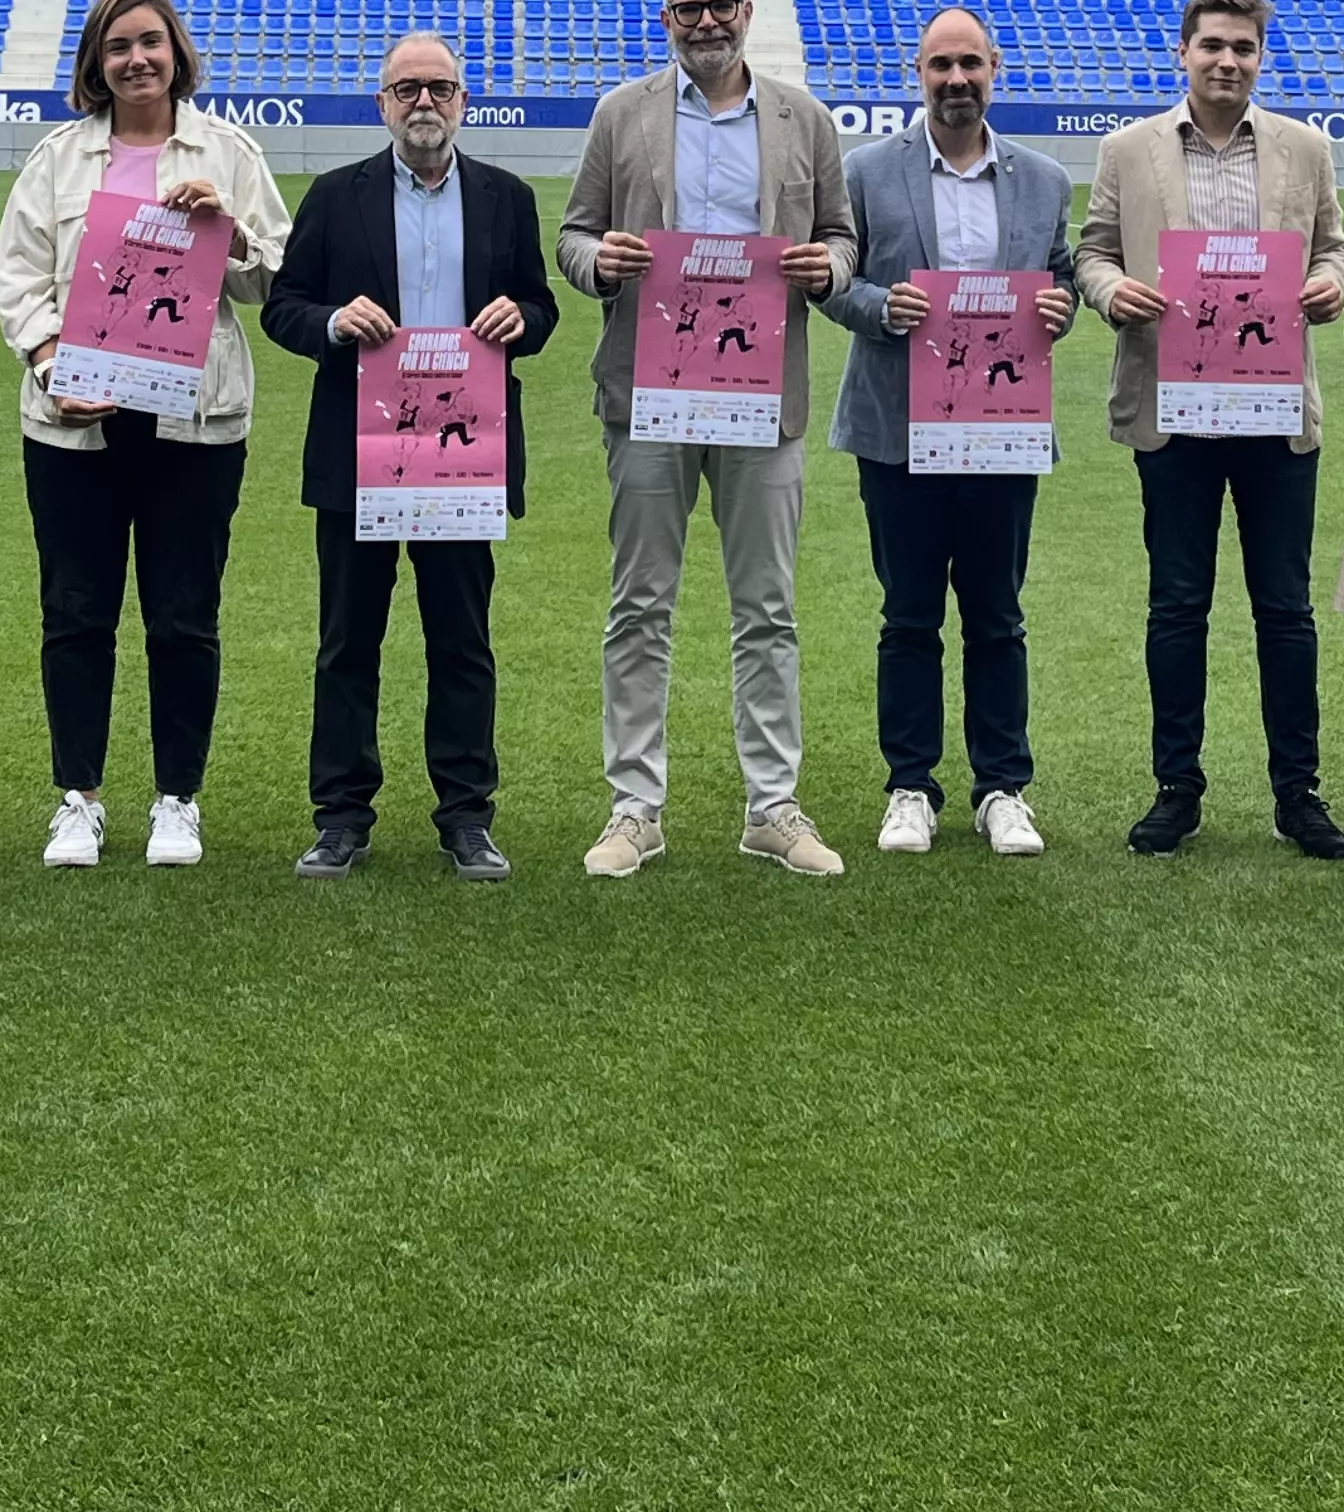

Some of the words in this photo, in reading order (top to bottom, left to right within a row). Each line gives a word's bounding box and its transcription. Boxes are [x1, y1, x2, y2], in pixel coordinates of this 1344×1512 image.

[464, 106, 525, 125] amon
[144, 222, 156, 242] LA
[702, 257, 714, 276] LA
[1217, 254, 1229, 272] LA
[969, 294, 980, 312] LA
[419, 352, 431, 371] LA
